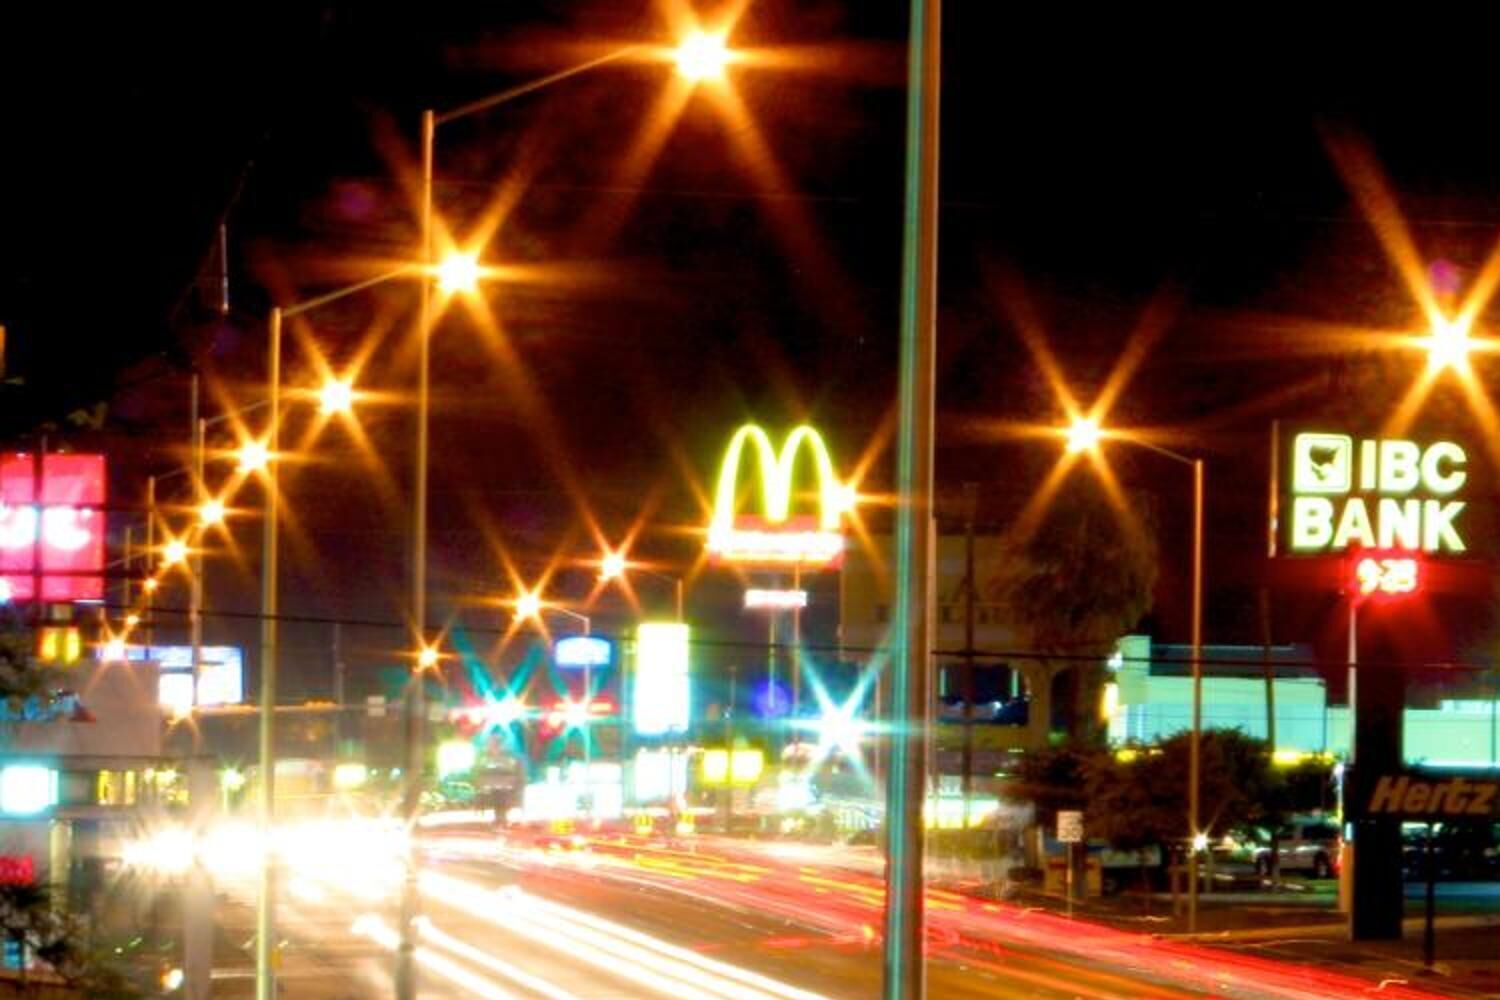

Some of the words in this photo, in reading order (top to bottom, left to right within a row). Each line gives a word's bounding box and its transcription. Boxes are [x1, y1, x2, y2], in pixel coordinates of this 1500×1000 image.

[1361, 439, 1467, 493] IBC
[1292, 496, 1467, 553] BANK
[1368, 775, 1497, 814] Hertz
